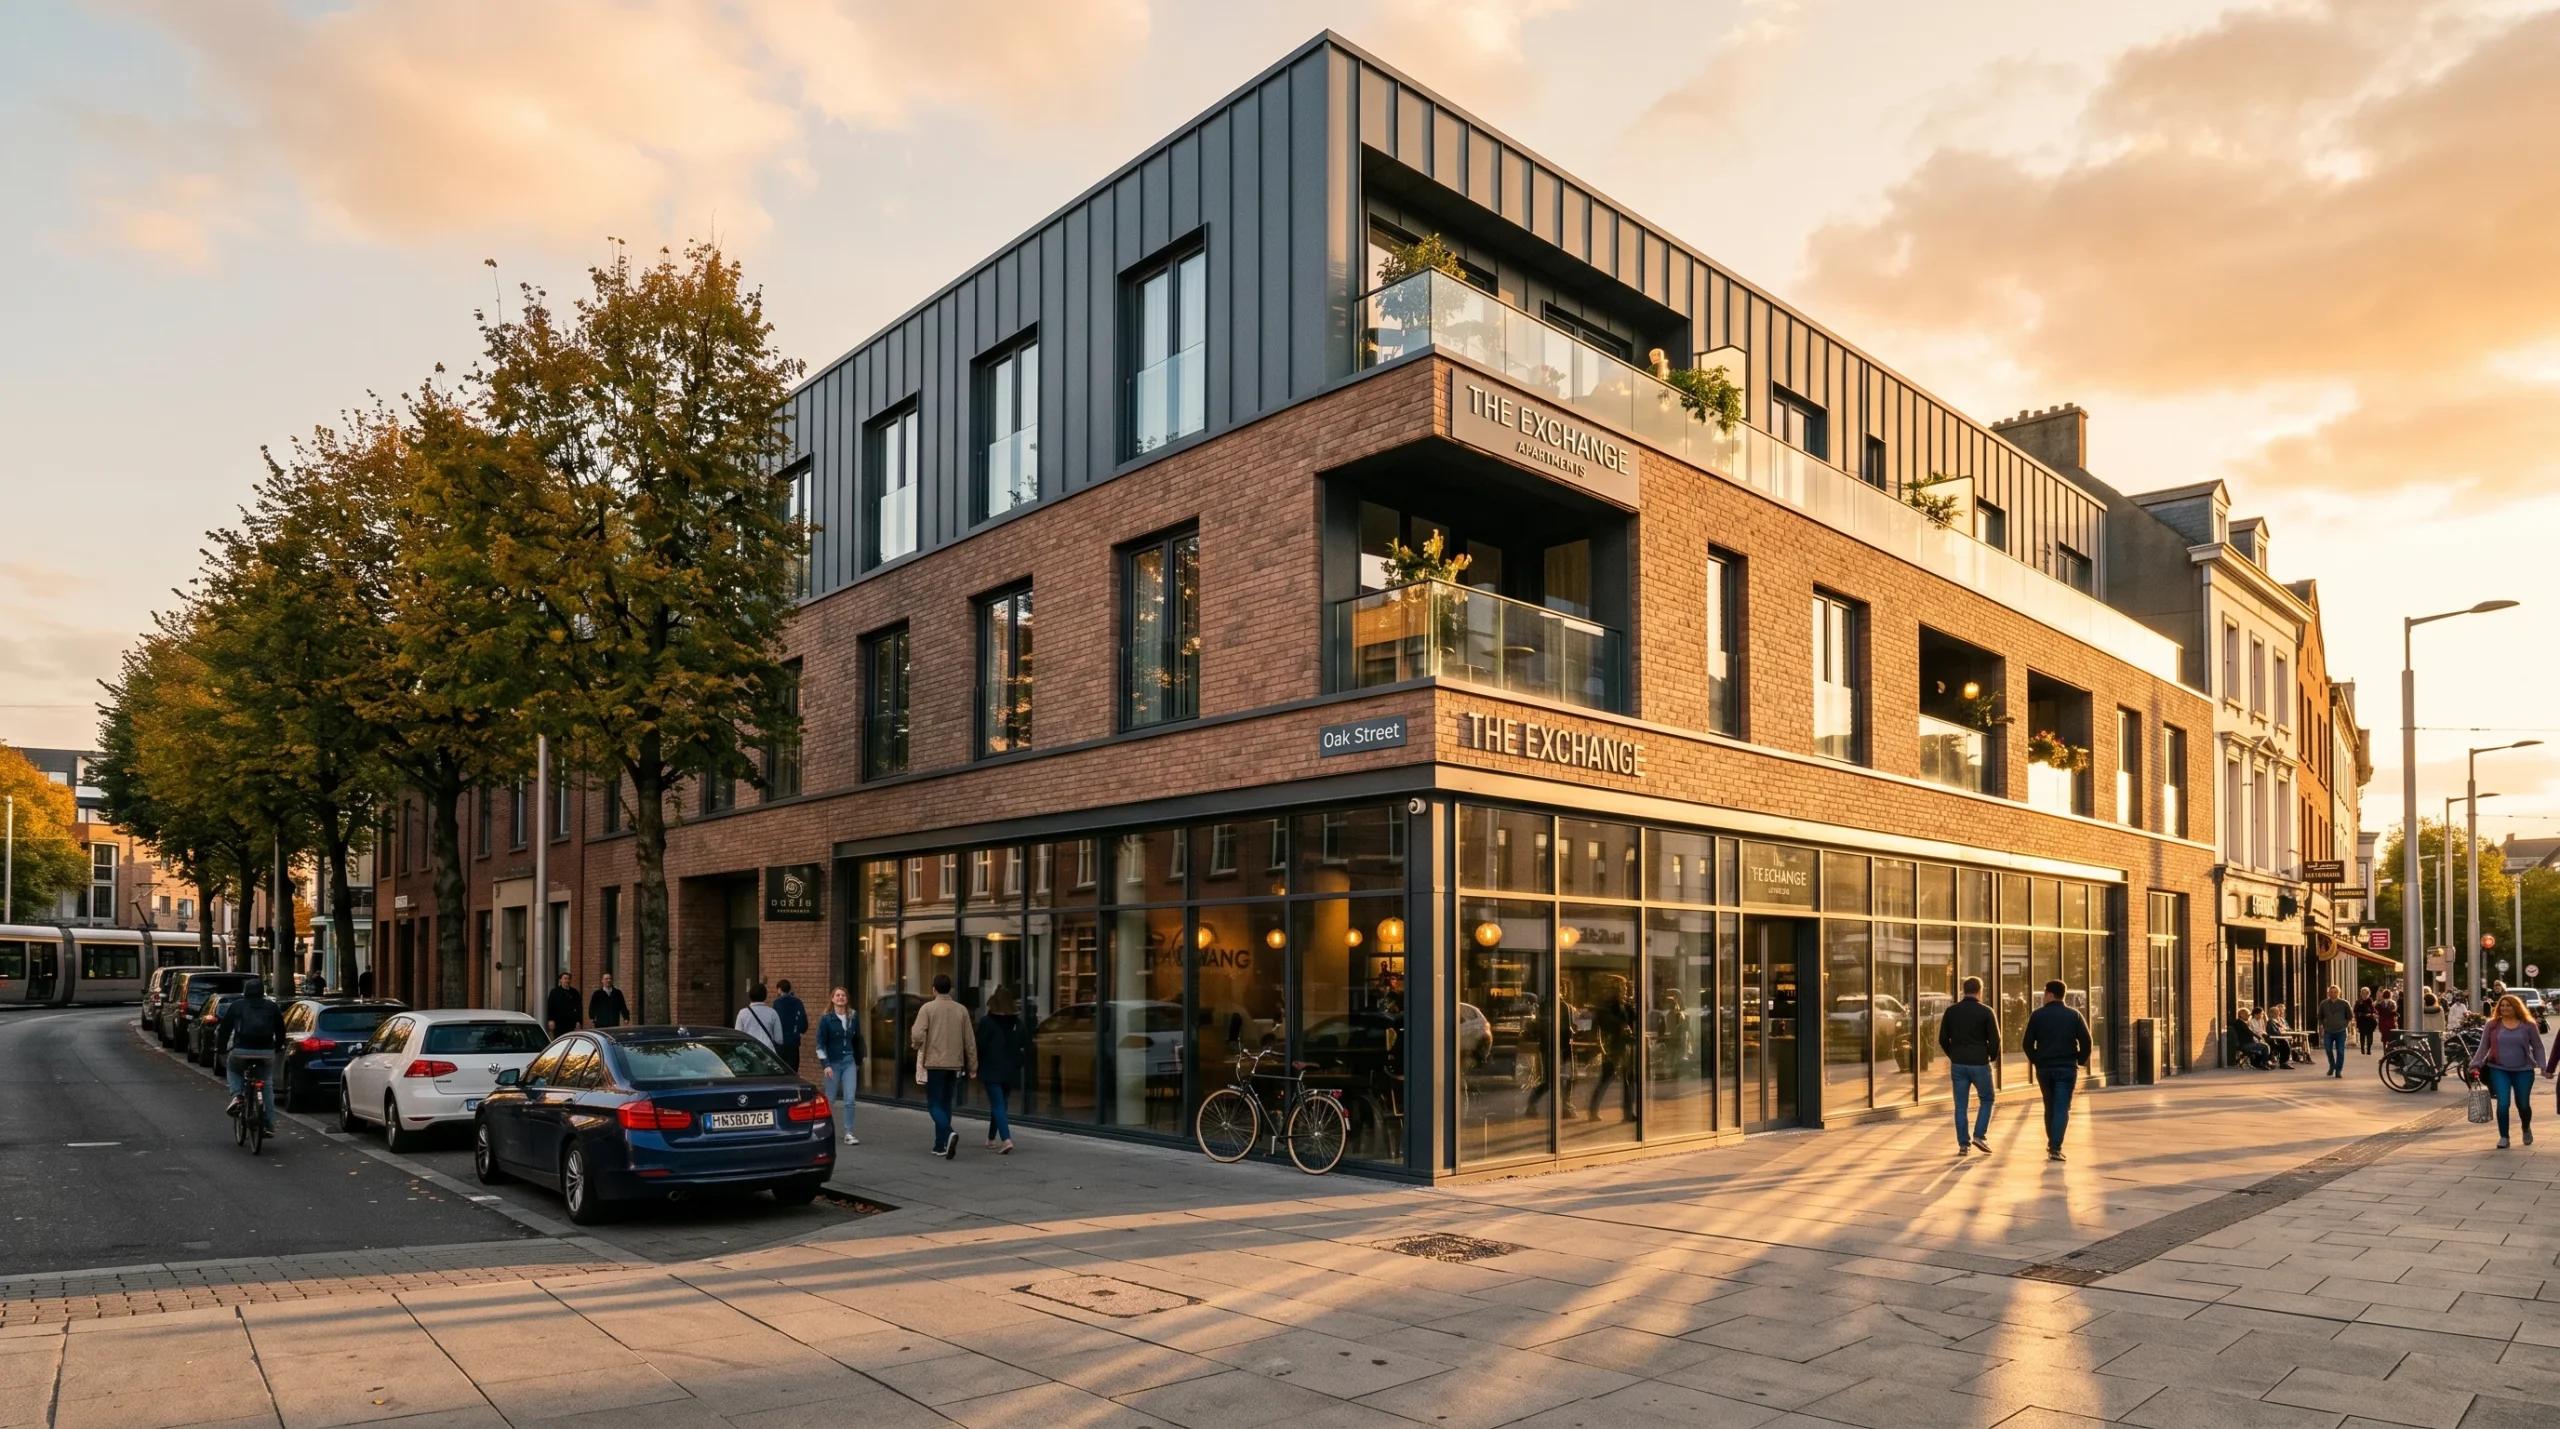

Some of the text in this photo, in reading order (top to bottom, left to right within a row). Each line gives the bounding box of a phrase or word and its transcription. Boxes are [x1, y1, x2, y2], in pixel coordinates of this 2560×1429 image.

[1467, 384, 1630, 476] THE EXCHANGE
[1516, 441, 1587, 478] APARTMENTS
[1323, 722, 1400, 748] Oak Street
[1468, 711, 1648, 777] THE EXCHANGE
